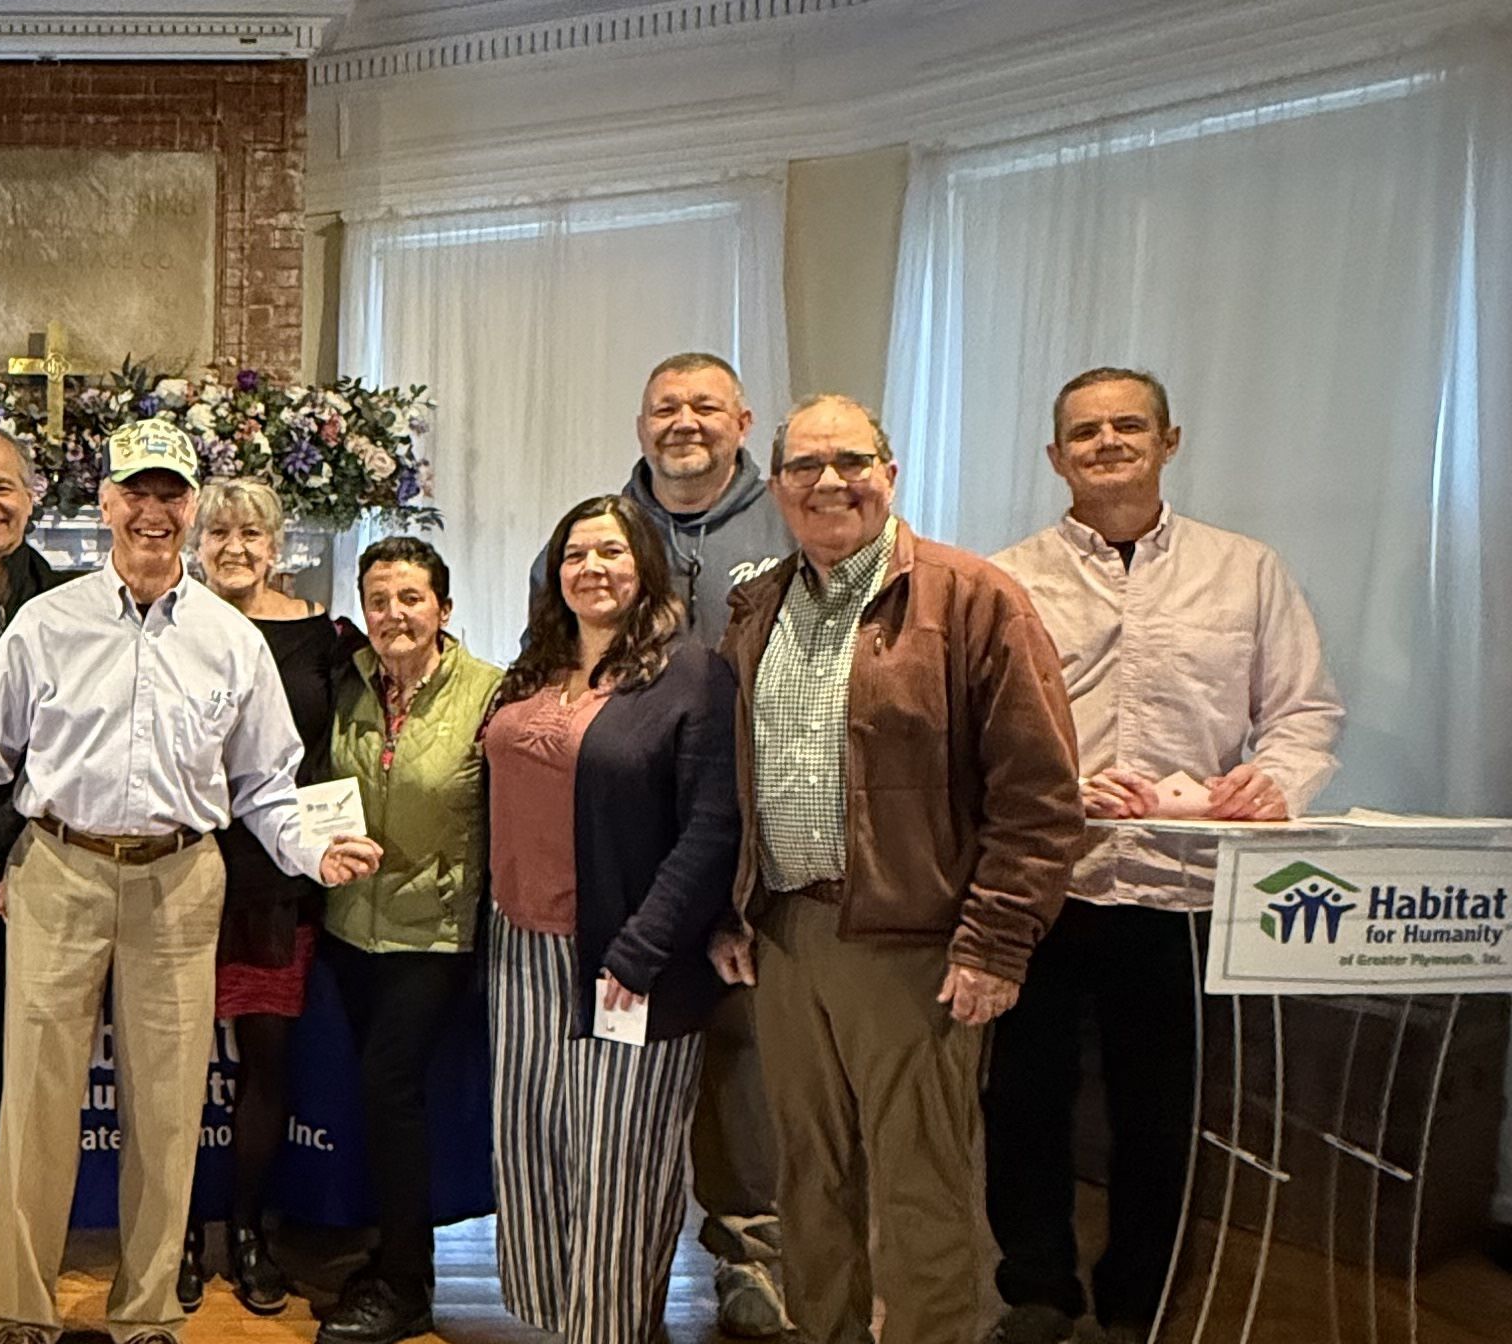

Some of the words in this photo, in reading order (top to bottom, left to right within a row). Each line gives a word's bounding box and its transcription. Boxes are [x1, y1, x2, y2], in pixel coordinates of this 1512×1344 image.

[1367, 884, 1508, 921] Habitat
[1366, 924, 1396, 944] for
[1403, 923, 1504, 948] Humanity
[288, 1115, 334, 1152] Inc.
